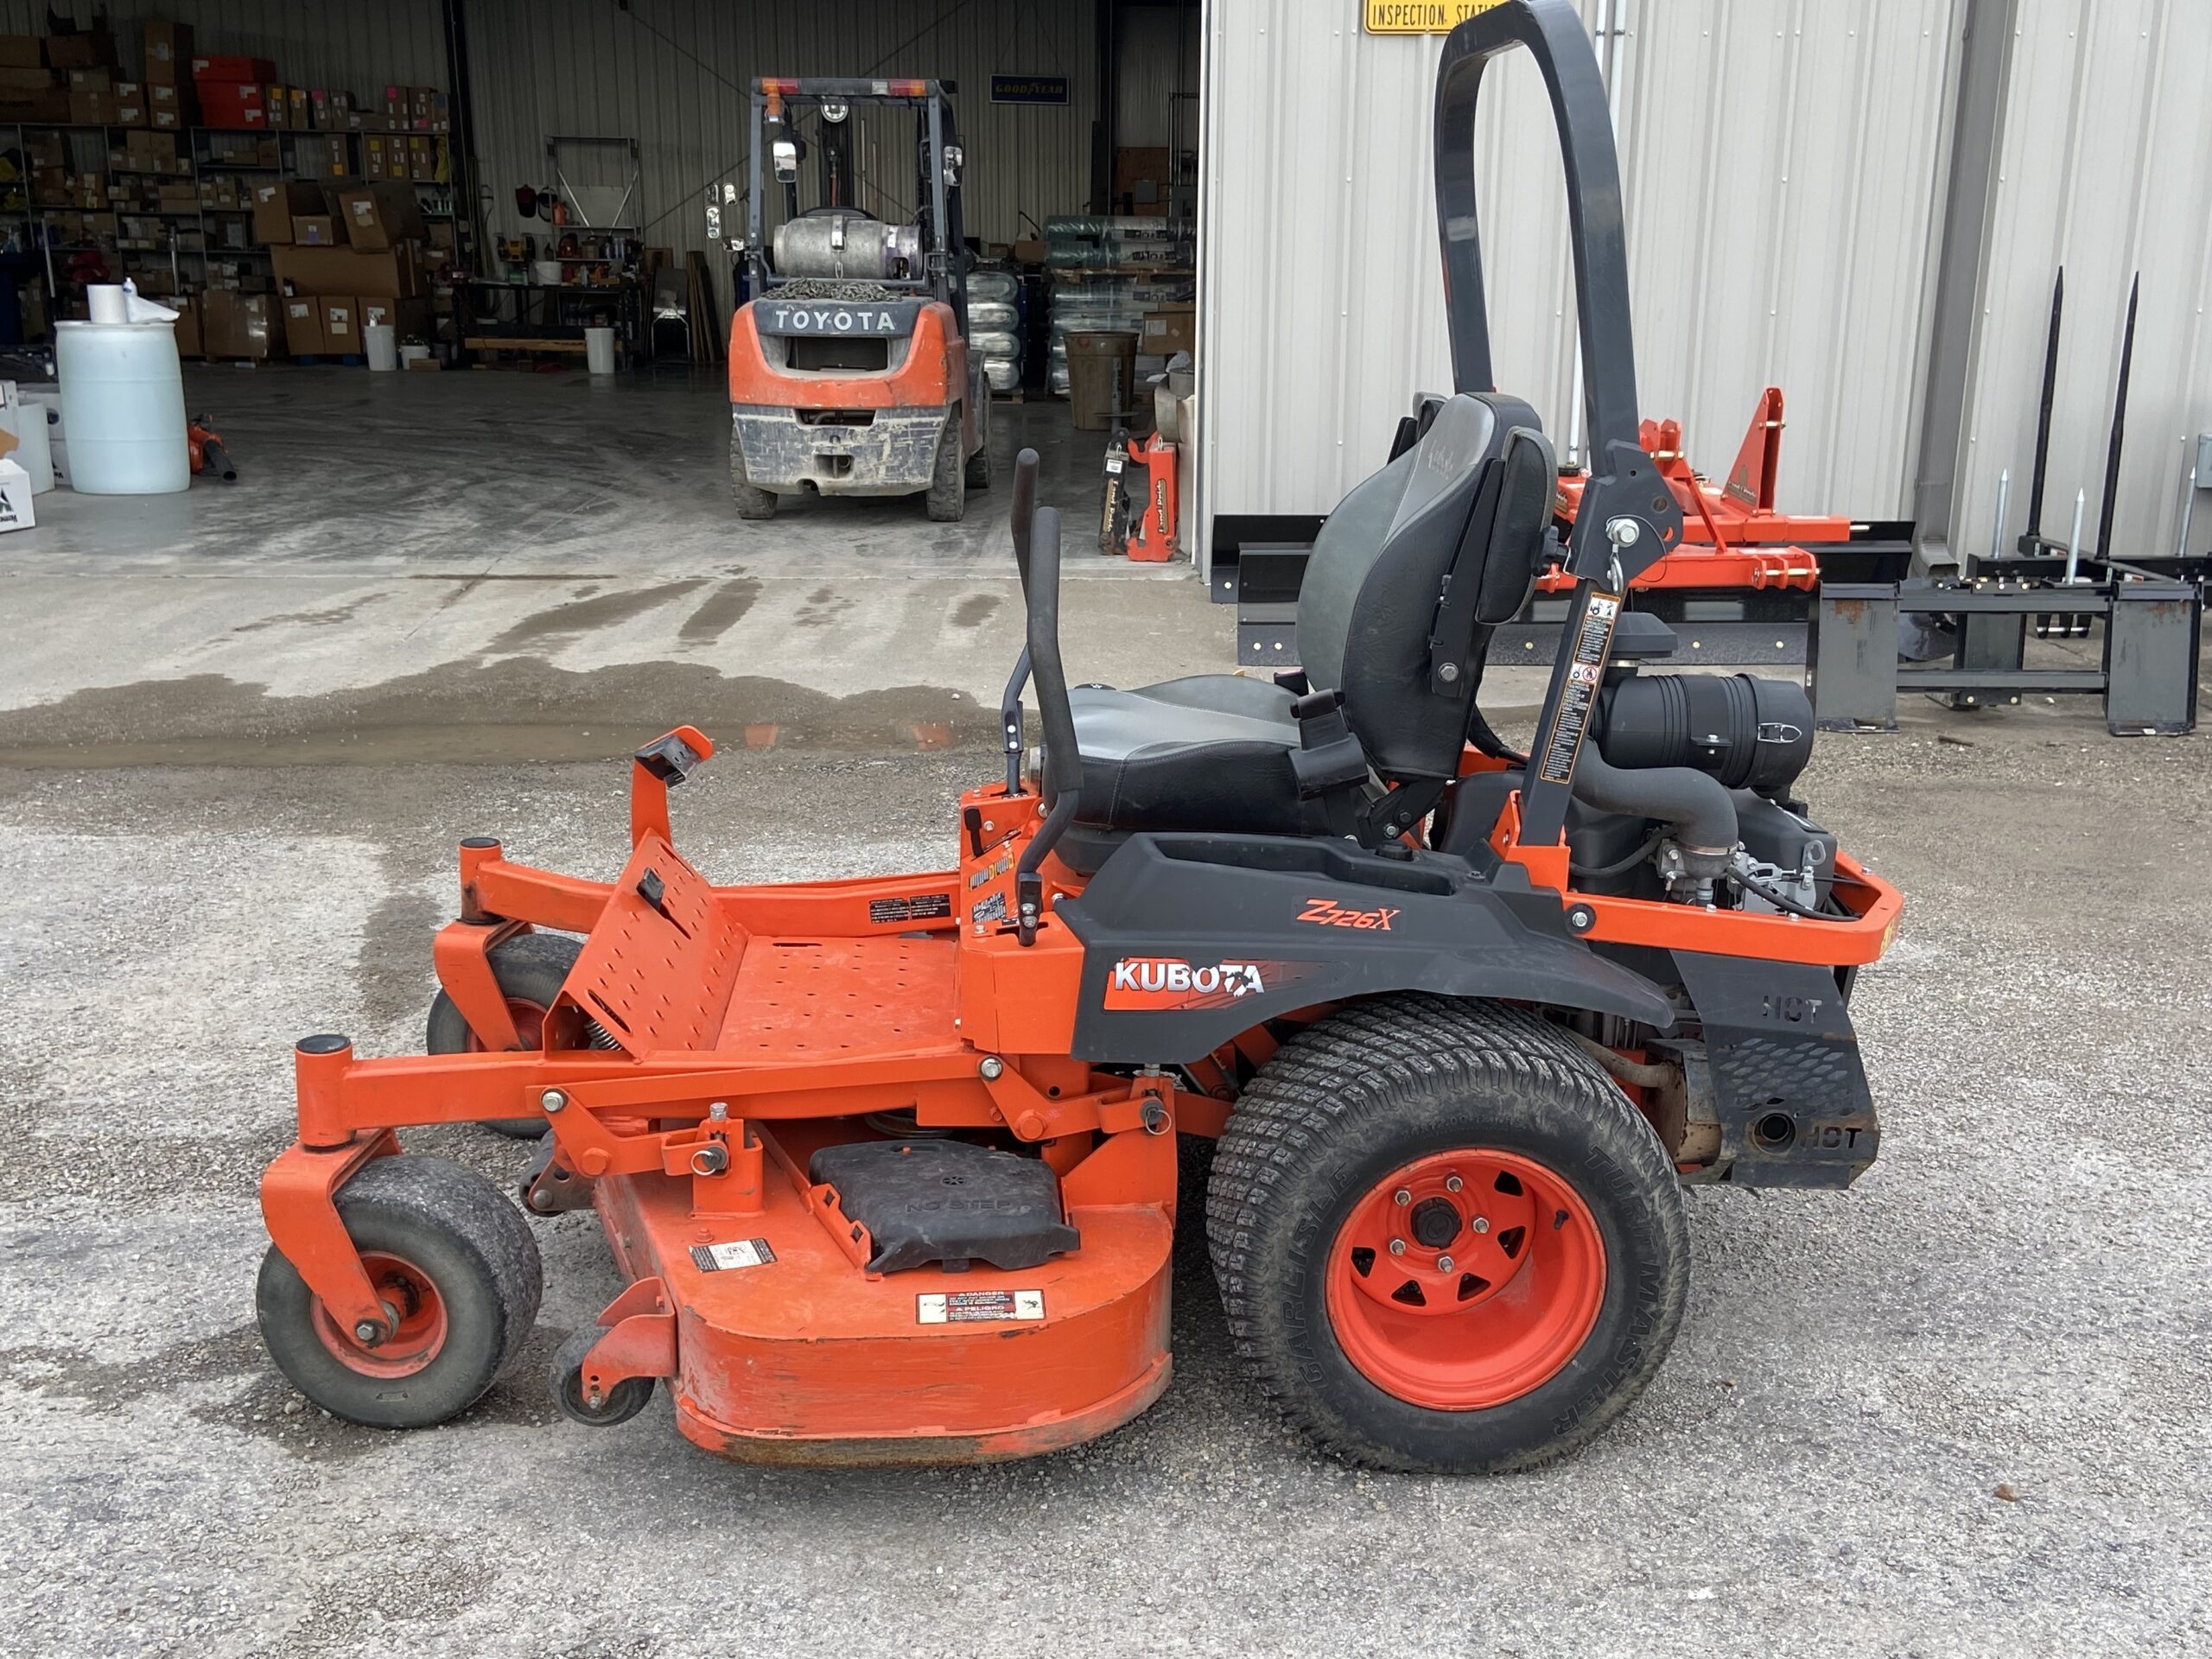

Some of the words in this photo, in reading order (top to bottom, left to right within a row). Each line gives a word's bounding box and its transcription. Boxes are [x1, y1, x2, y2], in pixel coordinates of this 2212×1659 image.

[1373, 4, 1445, 26] INSPECTION
[775, 310, 896, 331] TOYOTA
[1296, 899, 1401, 931] Z726X
[1115, 962, 1265, 997] KUBOTA
[1762, 995, 1823, 1024] HOT
[1800, 1126, 1863, 1149] HOT
[905, 1200, 941, 1213] NO
[947, 1199, 1011, 1211] STEP
